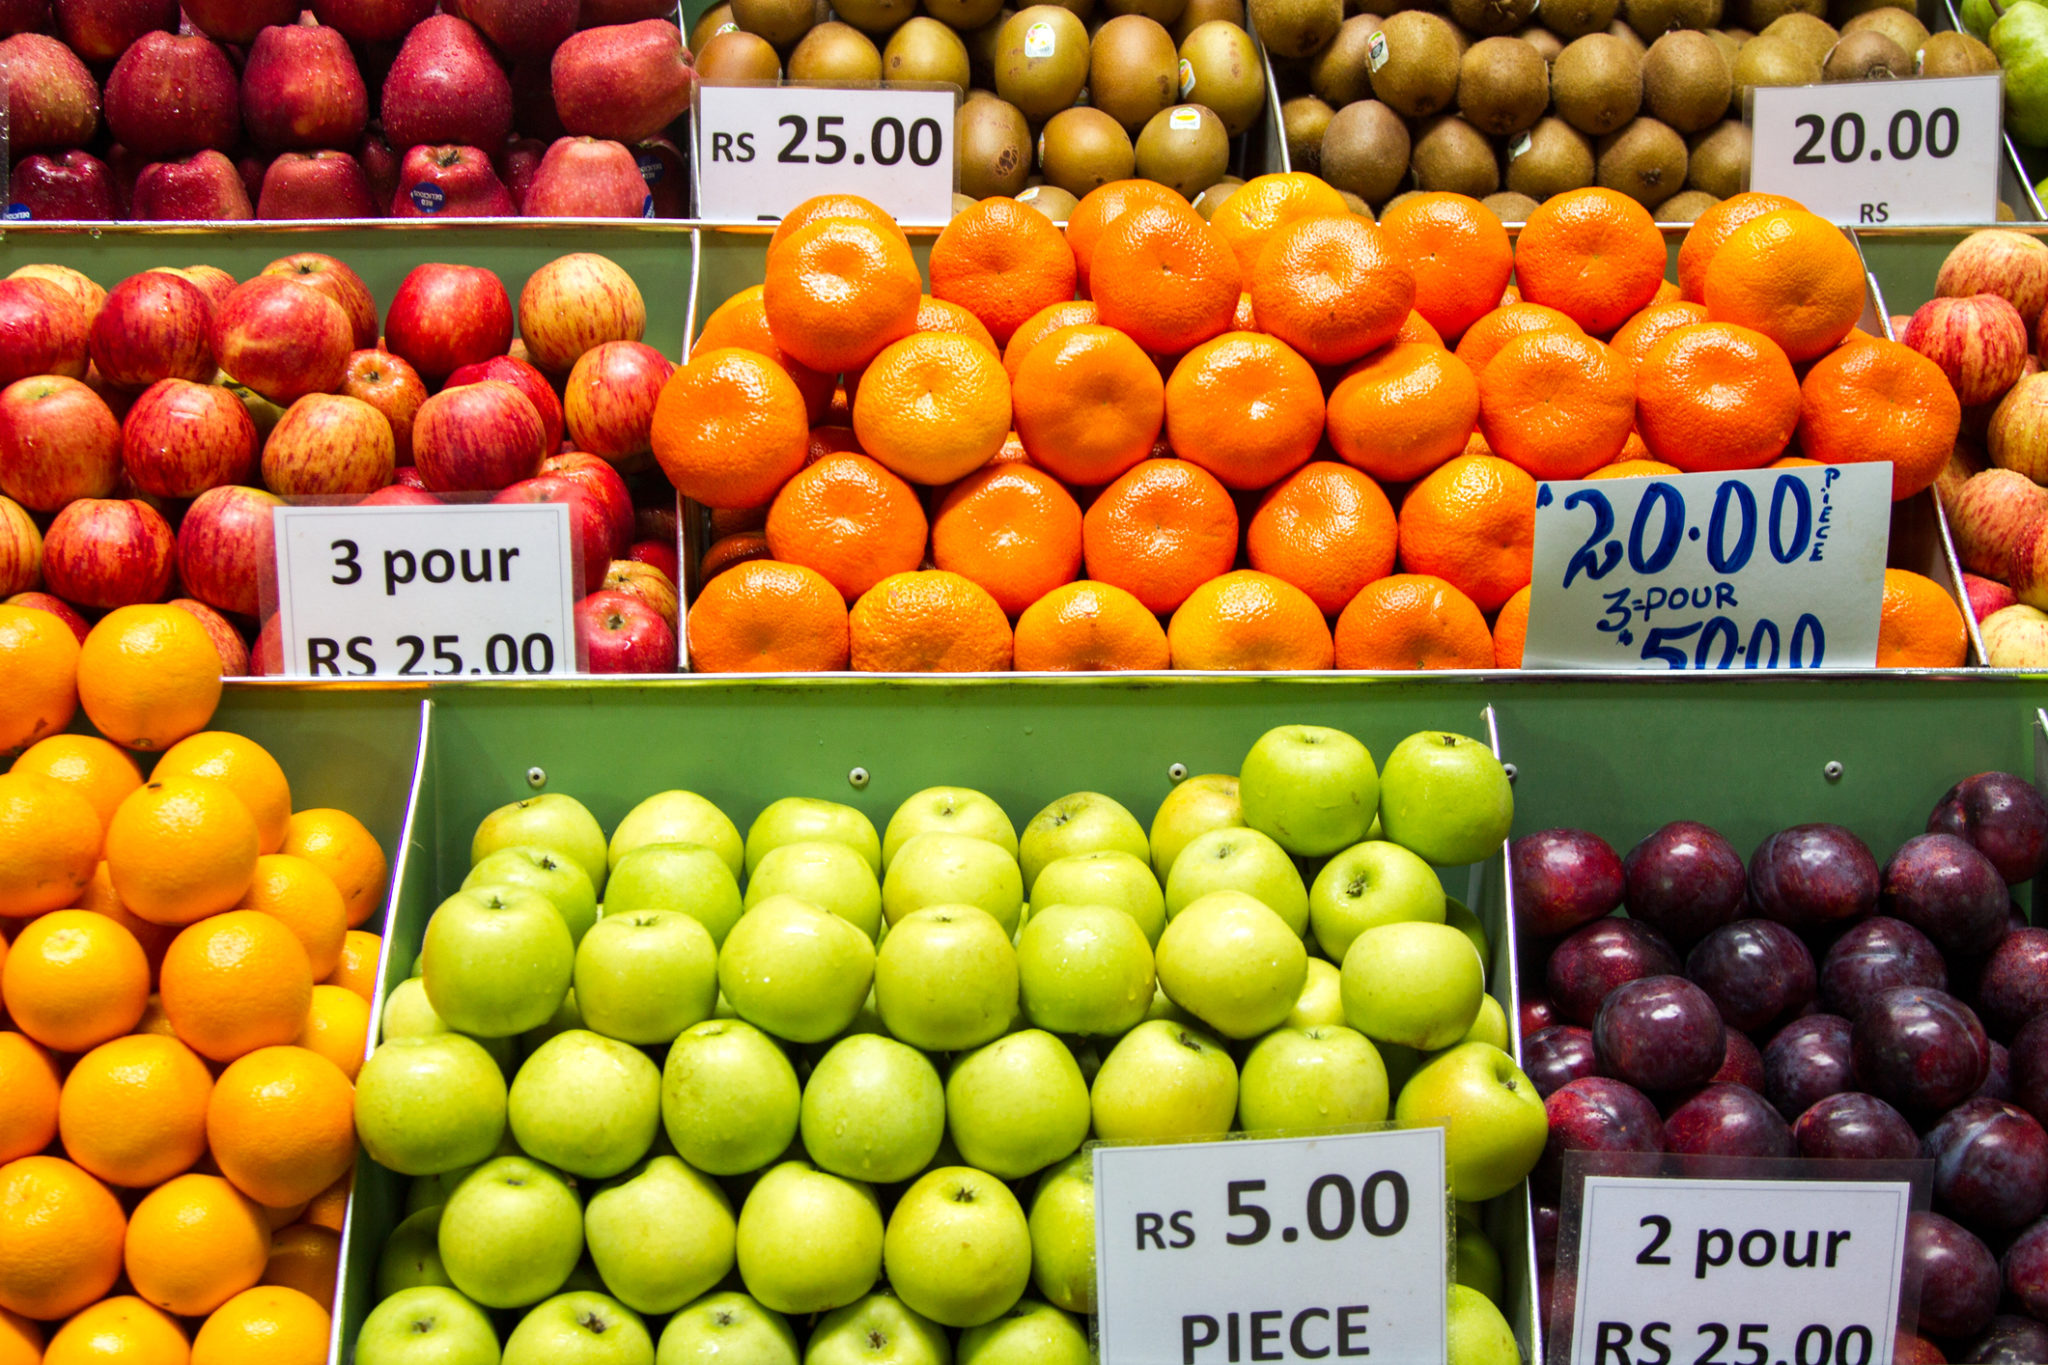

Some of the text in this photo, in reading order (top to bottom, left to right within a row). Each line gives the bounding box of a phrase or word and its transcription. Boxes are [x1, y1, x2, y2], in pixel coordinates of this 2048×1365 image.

[712, 114, 943, 167] RS 25.00
[1793, 107, 1960, 165] 20.00
[1860, 202, 1889, 223] RS
[1563, 473, 1812, 589] 20.00
[331, 539, 520, 596] 3 pour
[307, 632, 555, 676] RS 25.00
[1136, 1170, 1410, 1250] RS 5.00
[1636, 1215, 1851, 1279] 2 pour
[1182, 1305, 1371, 1365] PIECE
[1594, 1321, 1672, 1365] RS
